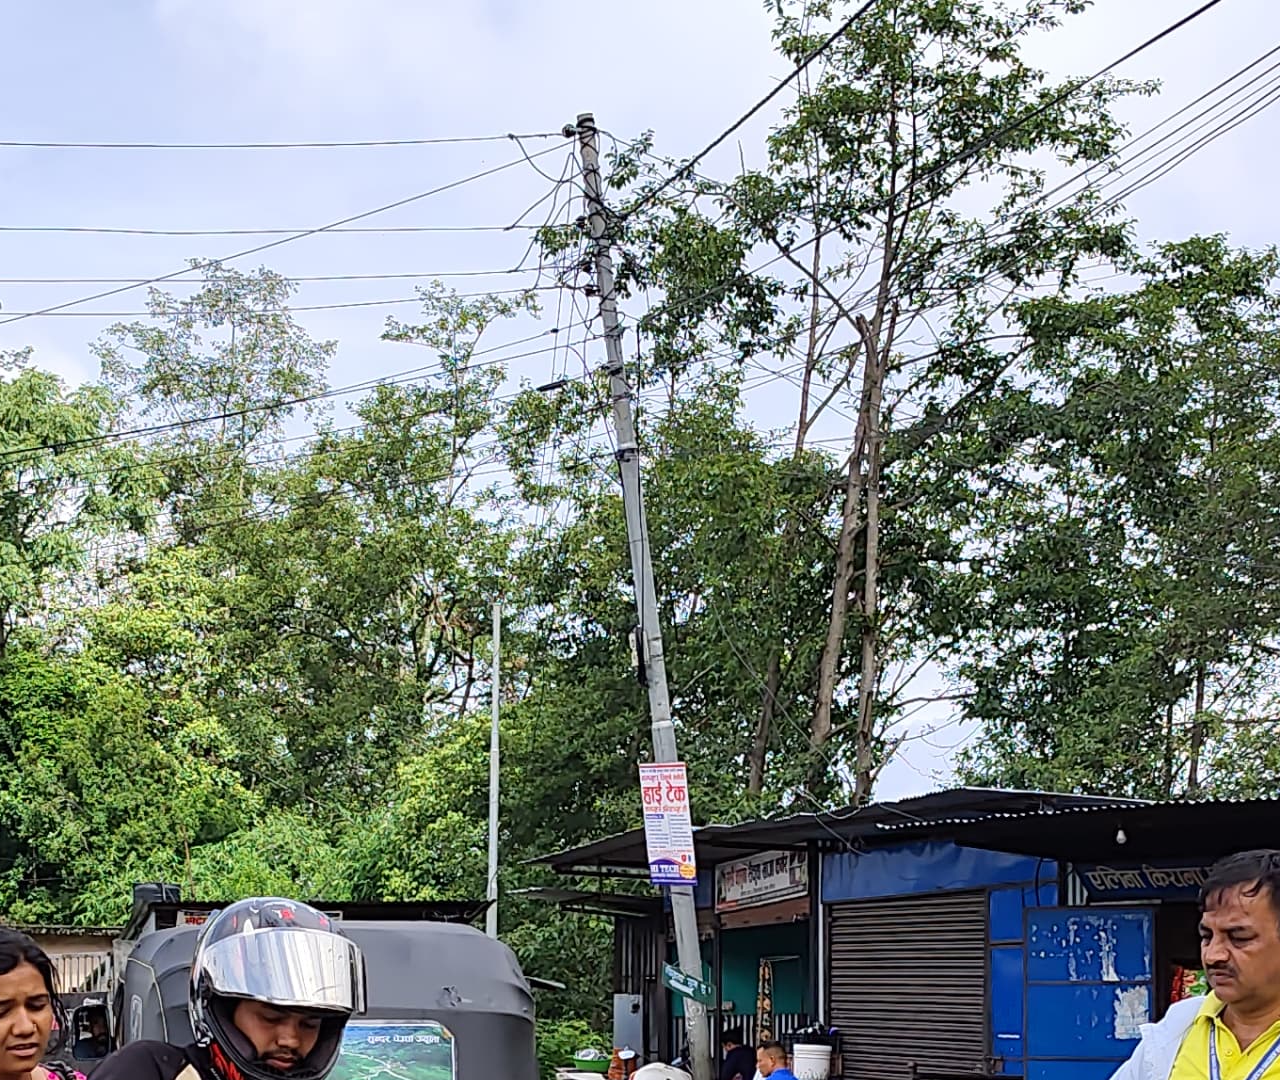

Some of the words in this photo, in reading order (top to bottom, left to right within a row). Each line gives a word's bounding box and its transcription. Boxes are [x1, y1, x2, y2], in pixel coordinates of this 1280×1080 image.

[643, 781, 663, 805] हाई
[665, 780, 686, 802] टेक
[1084, 866, 1146, 890] एलिना
